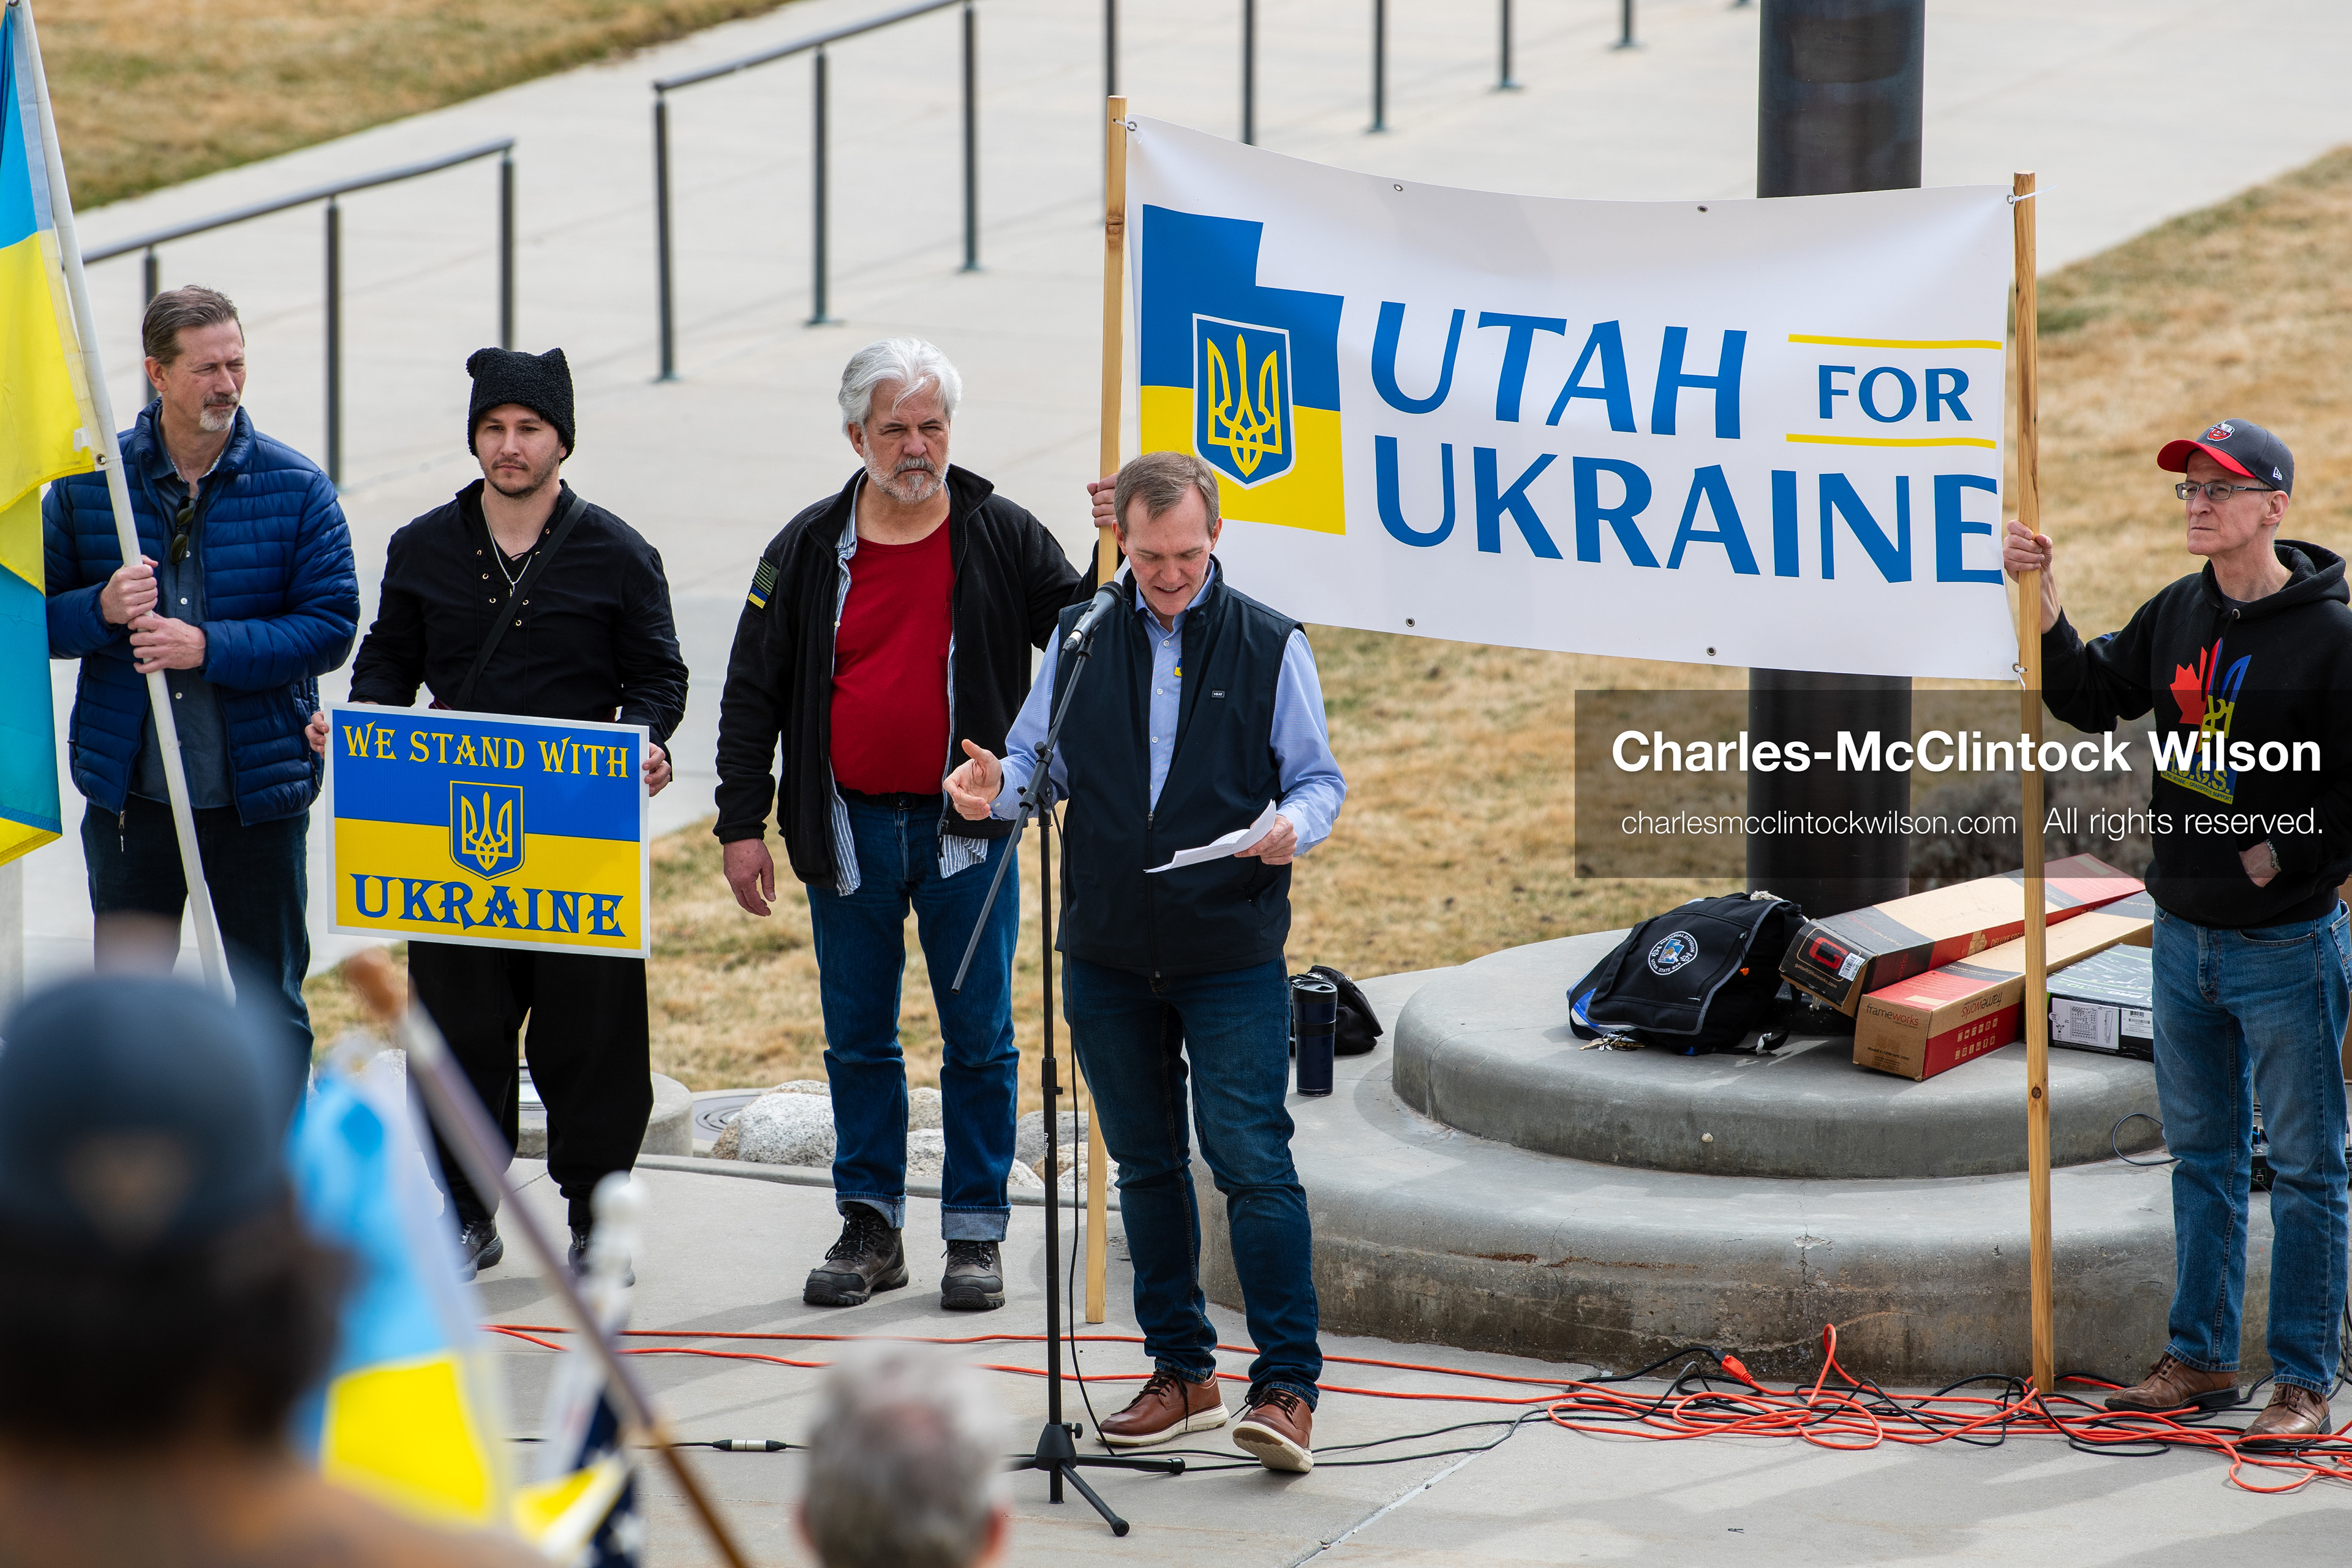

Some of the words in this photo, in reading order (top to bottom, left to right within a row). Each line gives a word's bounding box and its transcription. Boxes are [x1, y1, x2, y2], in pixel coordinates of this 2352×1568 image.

[1371, 301, 1747, 439] UTAH
[1817, 365, 1973, 423] FOR
[1374, 435, 2004, 586] UKRAINE
[342, 720, 397, 760] WE
[409, 731, 525, 770] STAND
[538, 734, 630, 778] WITH
[2189, 782, 2212, 795] GRASSROOTS
[2212, 792, 2233, 802] SUPPORT
[350, 873, 626, 937] UKRAINE
[1683, 935, 1695, 952] DIVISION
[1794, 963, 1838, 989] gatorframeworks.com
[1866, 1003, 1919, 1026] frameworks
[1961, 992, 2003, 1019] frameworks
